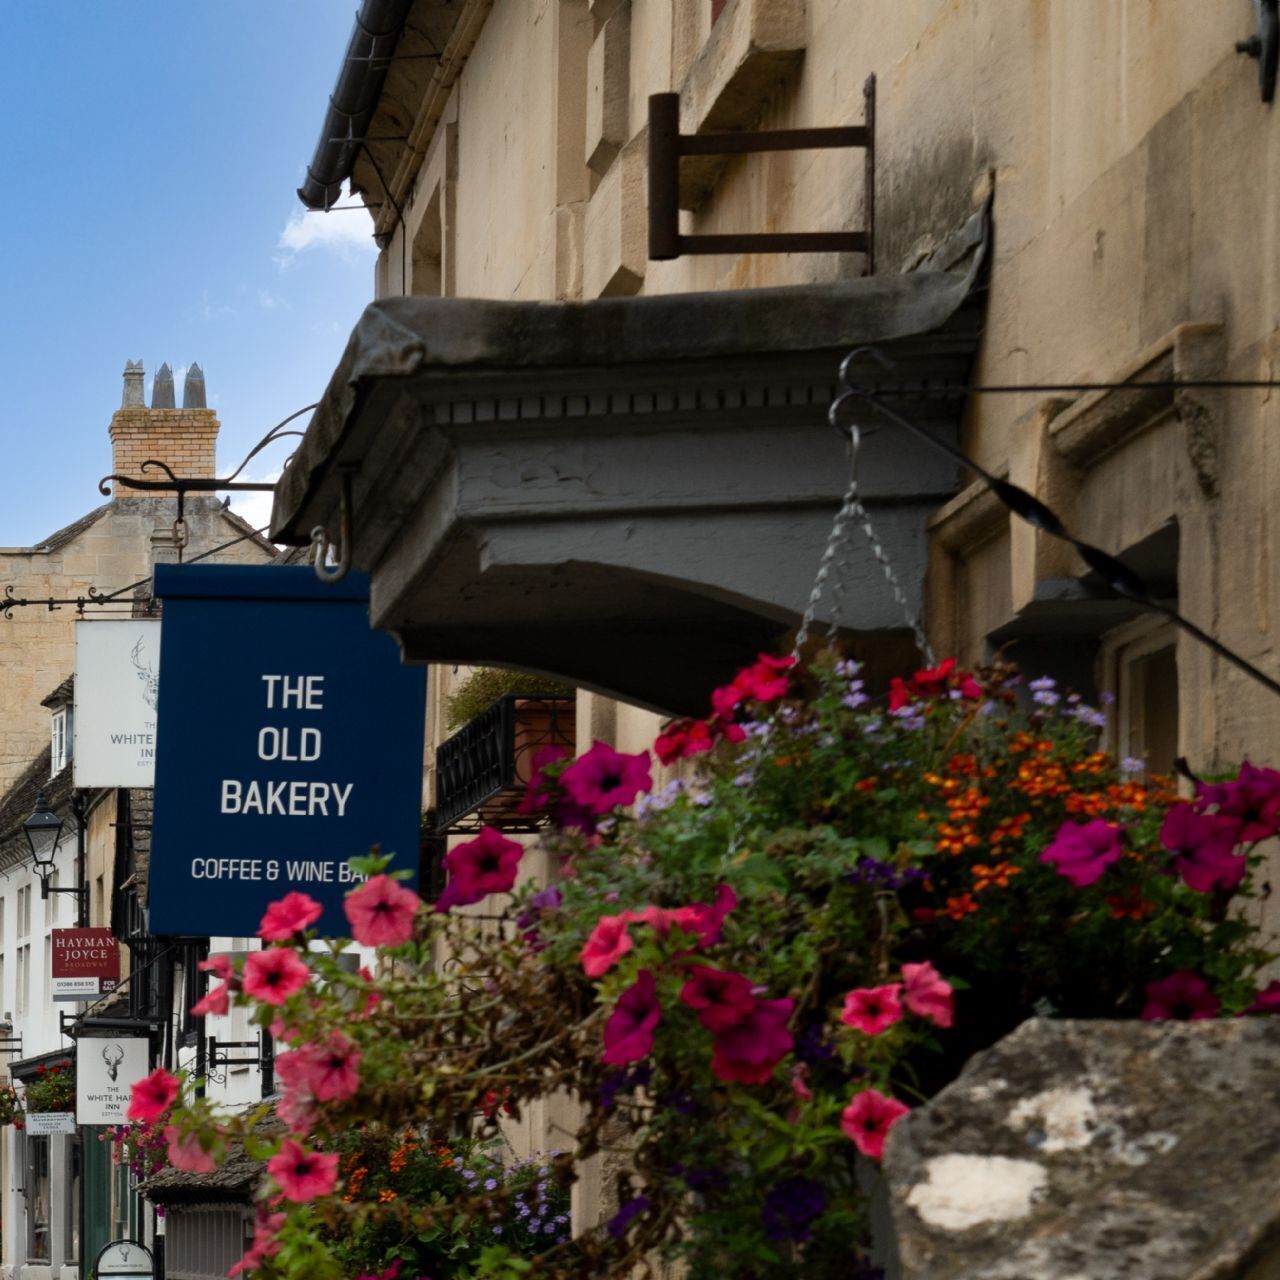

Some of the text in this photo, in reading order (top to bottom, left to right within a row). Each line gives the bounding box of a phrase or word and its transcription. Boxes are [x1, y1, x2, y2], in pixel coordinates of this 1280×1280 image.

[261, 675, 325, 710] THE
[110, 734, 153, 745] WHITE
[258, 726, 322, 761] OLD
[141, 749, 154, 758] IN
[220, 779, 354, 816] BAKERY
[191, 858, 370, 883] COFFEE & WINE BA
[56, 937, 115, 948] HAYMAN
[87, 1094, 134, 1102] WHITE HAR
